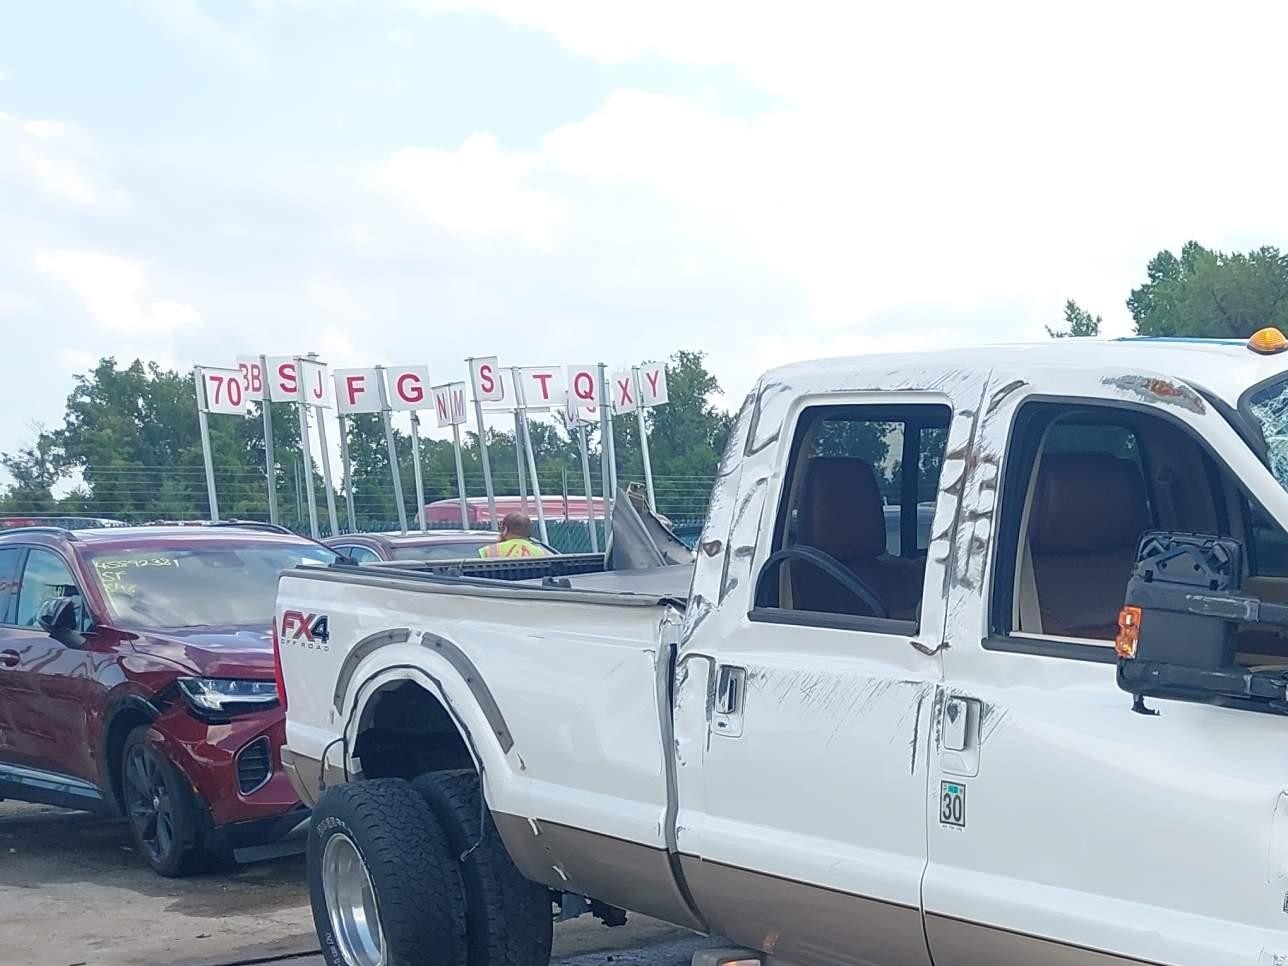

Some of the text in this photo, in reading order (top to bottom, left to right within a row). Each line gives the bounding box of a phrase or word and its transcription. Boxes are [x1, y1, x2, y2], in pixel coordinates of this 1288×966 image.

[209, 376, 242, 406] 70
[278, 364, 297, 392] S
[313, 369, 323, 399] J
[346, 376, 365, 405] F
[397, 374, 424, 402] G
[480, 365, 494, 393] S
[532, 374, 552, 400] T
[574, 372, 594, 400] Q
[617, 378, 633, 406] X
[646, 370, 658, 397] Y
[437, 392, 447, 420] N
[281, 610, 330, 644] FX4
[942, 792, 962, 822] 30
